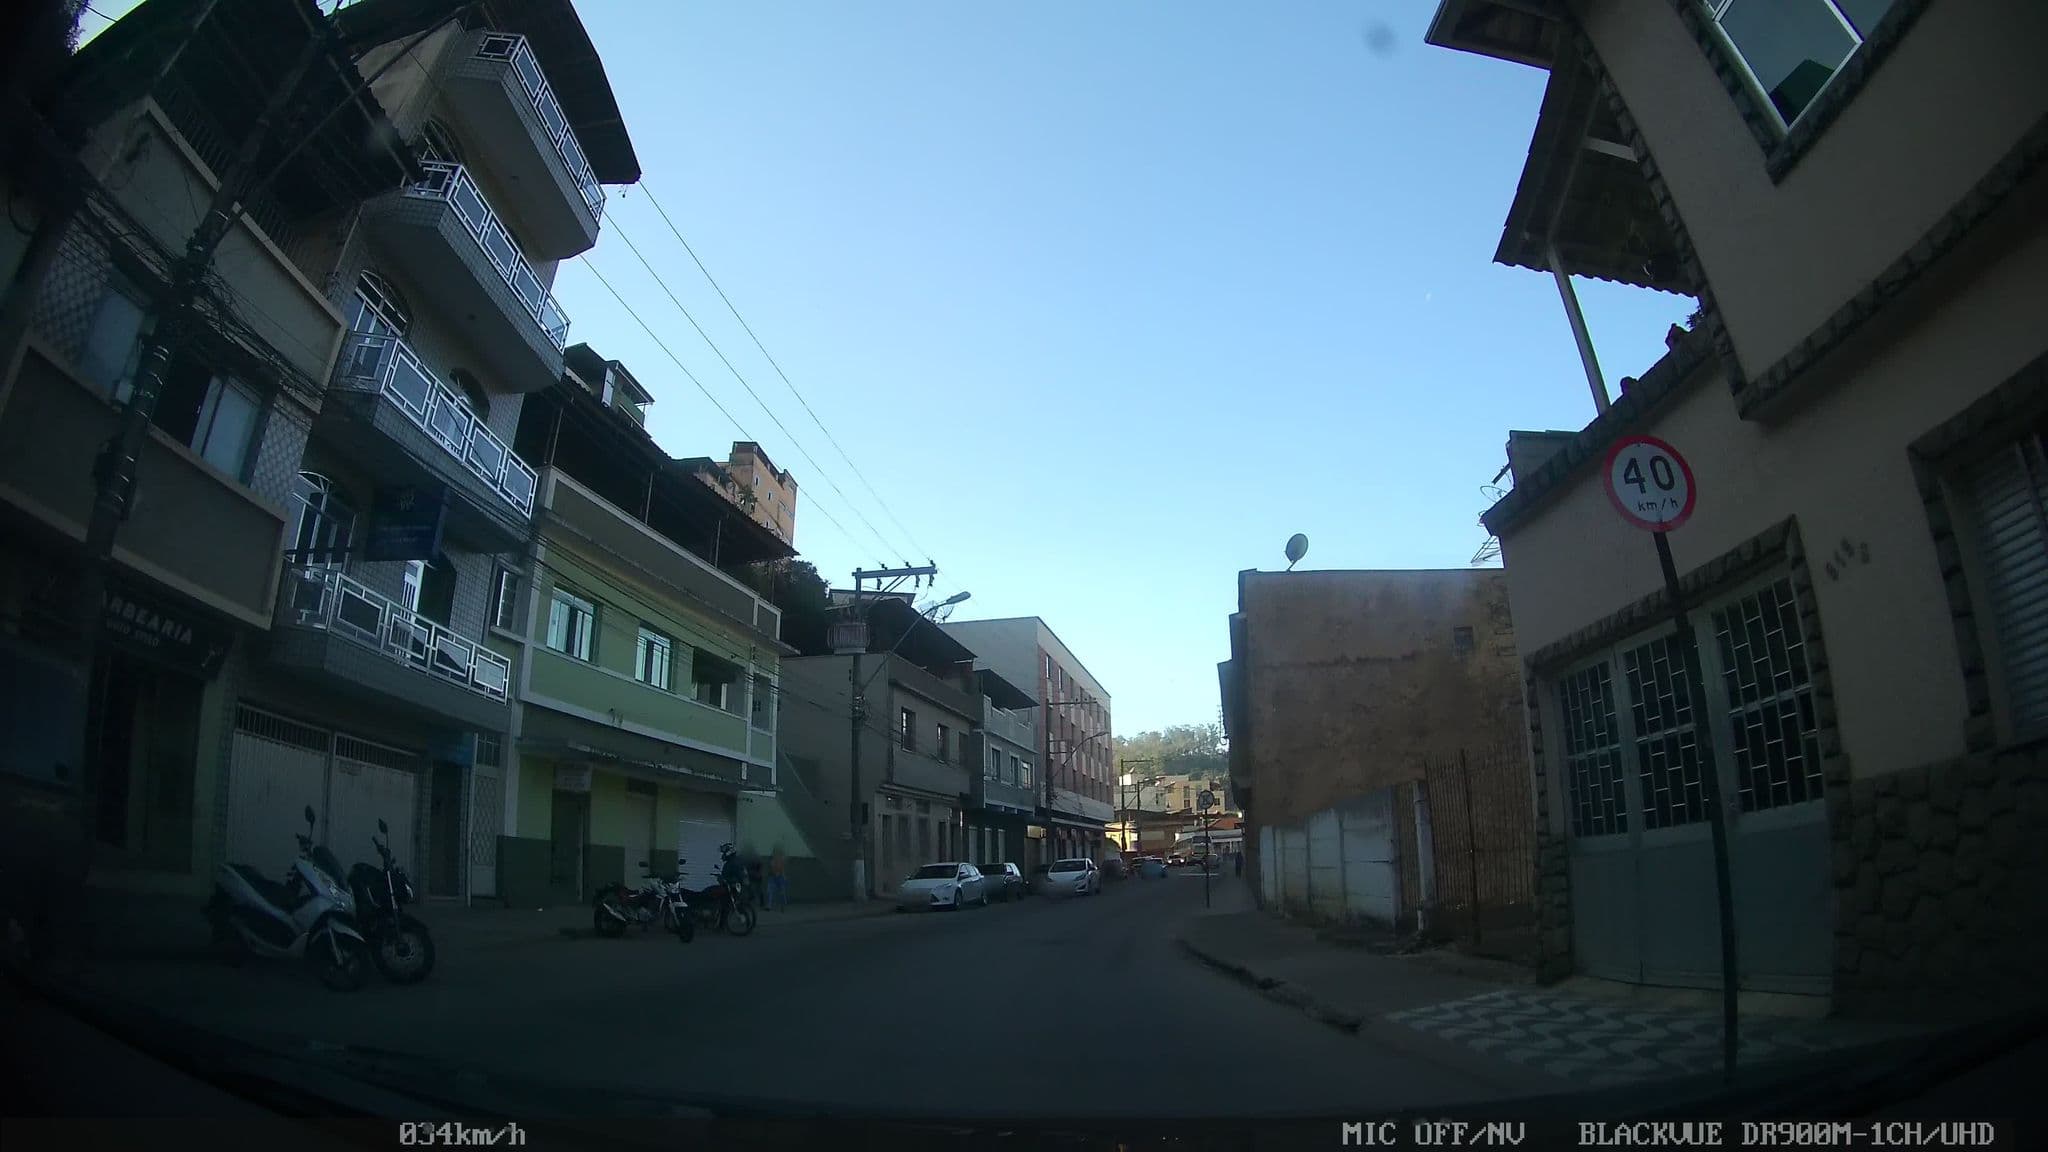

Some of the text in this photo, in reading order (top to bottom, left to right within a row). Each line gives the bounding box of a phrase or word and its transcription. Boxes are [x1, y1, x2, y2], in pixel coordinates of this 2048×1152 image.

[1624, 455, 1675, 494] 40
[1638, 498, 1679, 512] km/h
[103, 590, 192, 646] RBEARIA
